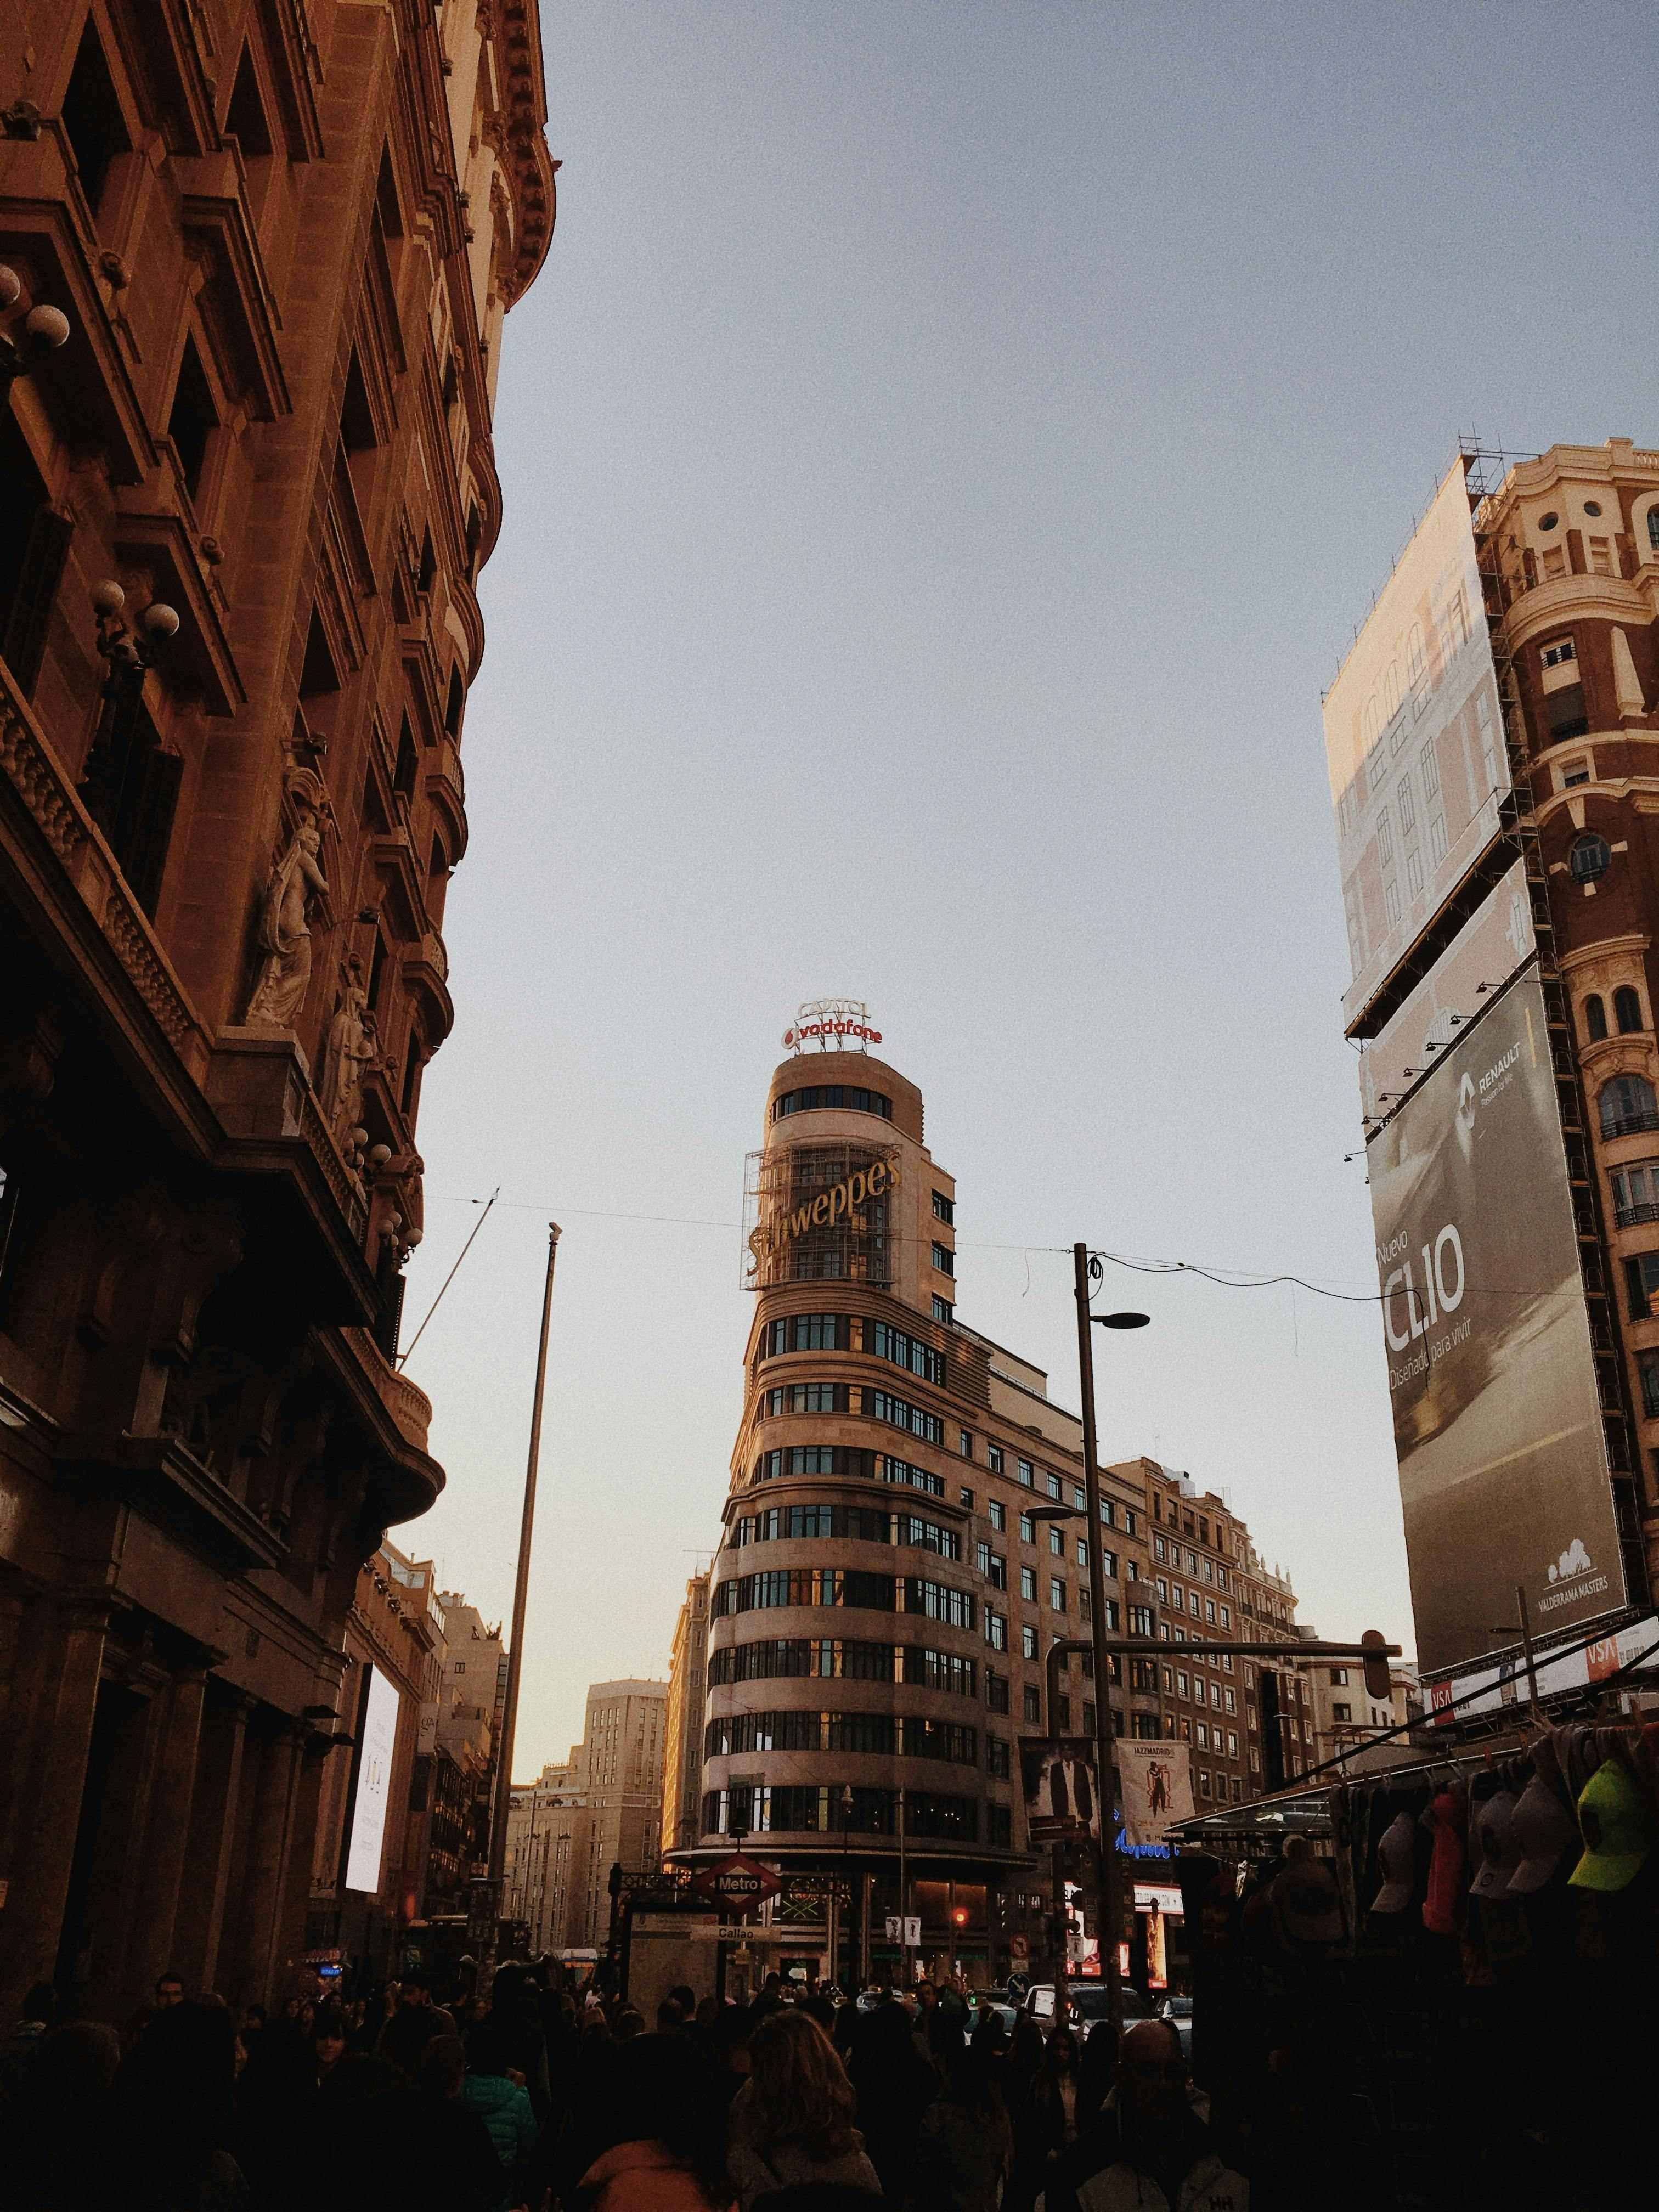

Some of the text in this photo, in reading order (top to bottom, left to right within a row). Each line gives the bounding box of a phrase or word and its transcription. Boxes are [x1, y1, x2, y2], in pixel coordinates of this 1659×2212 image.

[798, 996, 870, 1018] CAPITOL
[799, 1019, 882, 1044] vodafone
[1479, 1042, 1520, 1094] RENAULT
[1377, 1230, 1408, 1266] Nuevo
[1384, 1224, 1465, 1352] CLIO
[1389, 1316, 1471, 1390] Diseñado para vivir
[1538, 1575, 1609, 1613] VALDERRAMA MASTERS
[719, 1877, 758, 1891] Metro
[719, 1928, 754, 1938] Callao
